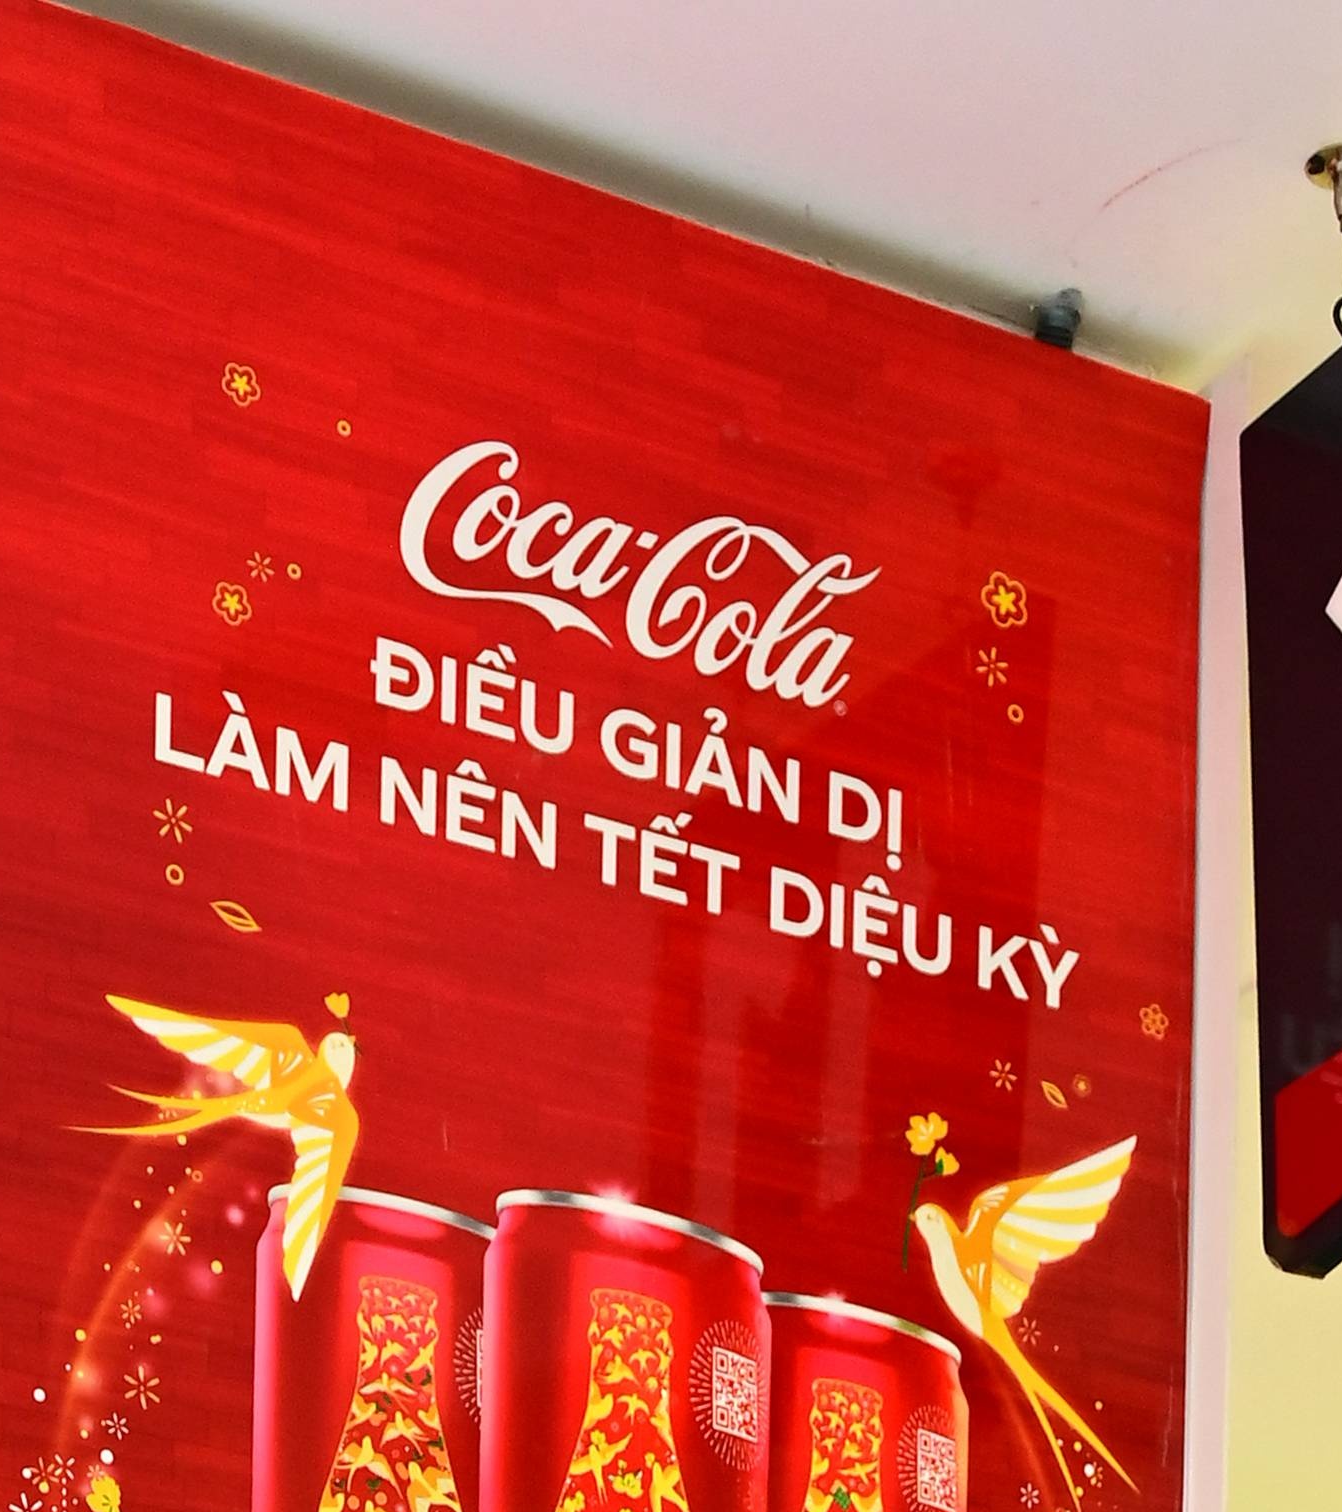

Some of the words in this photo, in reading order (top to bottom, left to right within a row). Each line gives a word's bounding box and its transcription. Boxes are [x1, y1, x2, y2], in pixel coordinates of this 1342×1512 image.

[399, 440, 882, 708] Coca-Cola
[154, 691, 350, 812] LÀM
[379, 757, 556, 871] NÊN
[583, 810, 741, 915] TẾT
[770, 868, 953, 979] DIỆU
[976, 922, 1080, 1011] KỲ
[370, 637, 574, 755] ĐIỀU
[601, 708, 799, 824] GIẢN
[828, 772, 902, 873] DỊ
